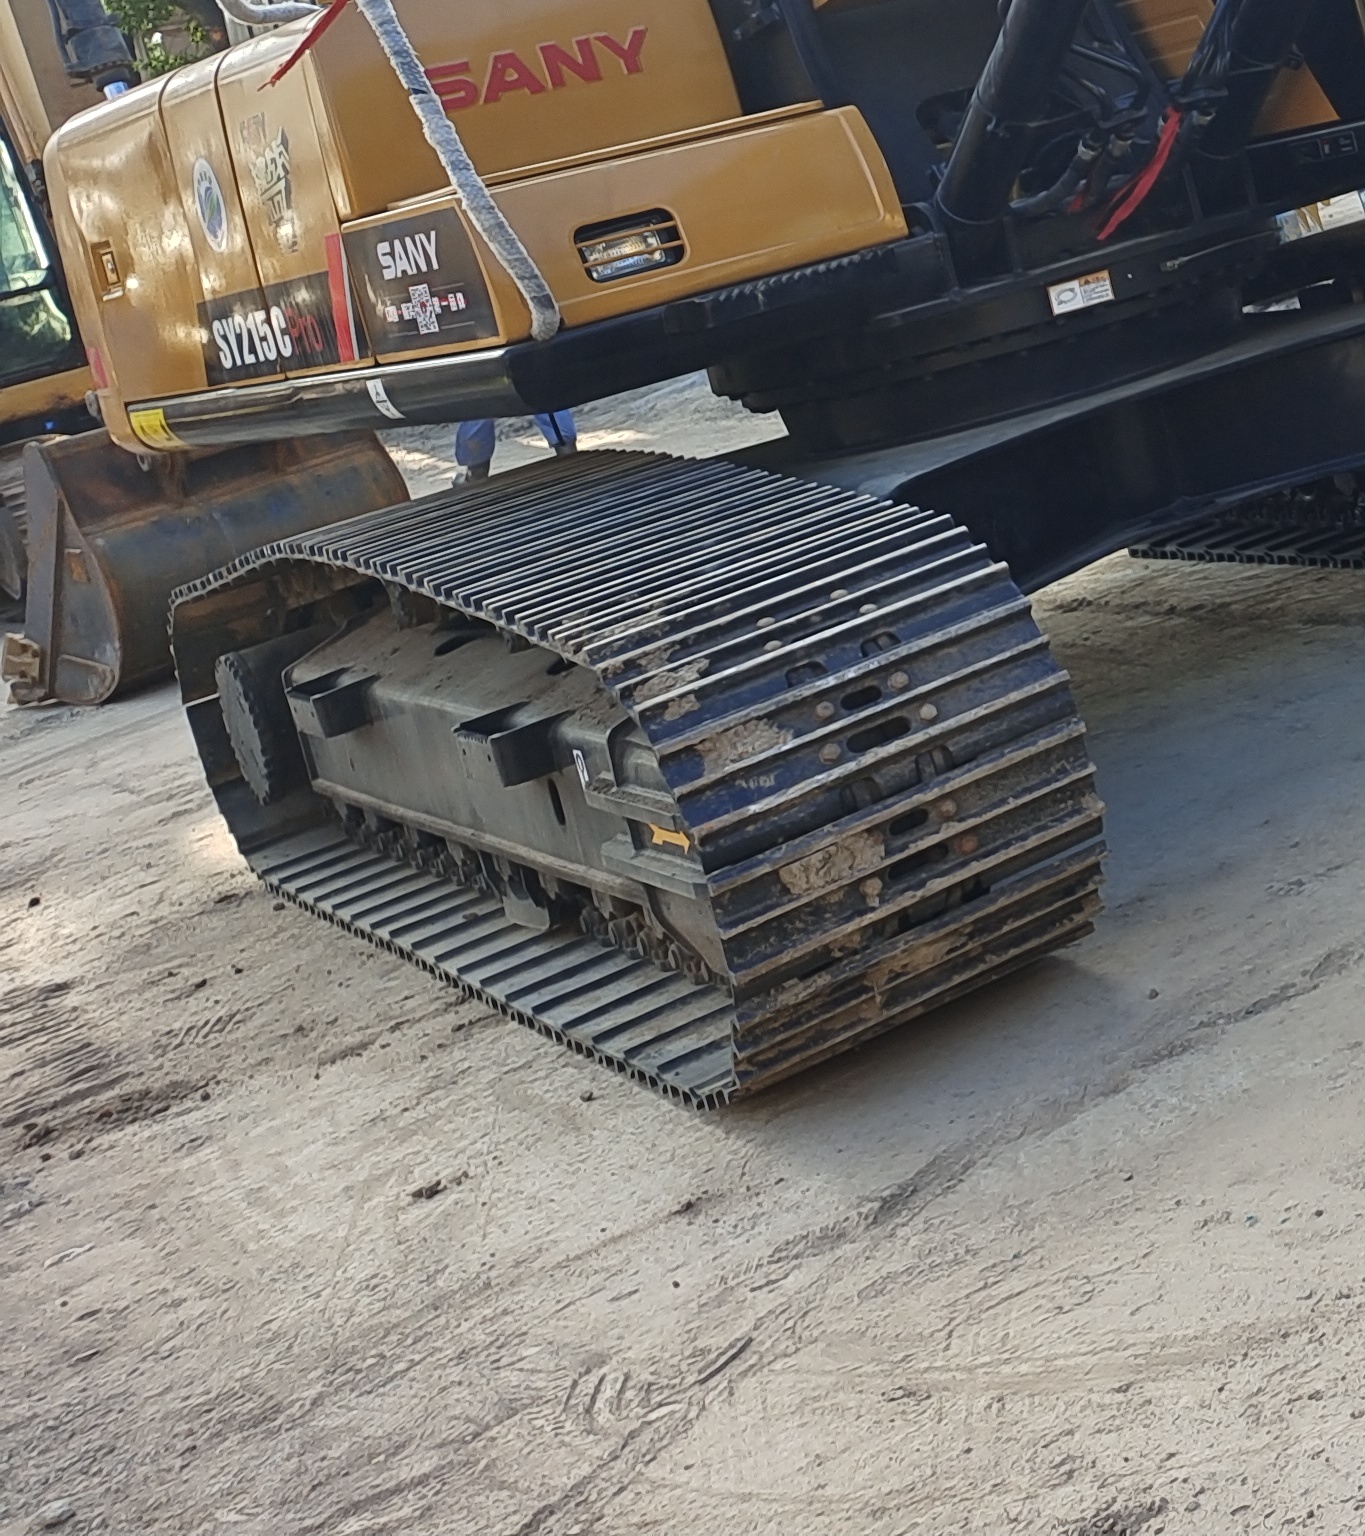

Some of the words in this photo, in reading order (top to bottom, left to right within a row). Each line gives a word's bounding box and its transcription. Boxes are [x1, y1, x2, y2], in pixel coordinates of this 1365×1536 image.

[424, 25, 648, 113] SANY
[376, 230, 439, 281] SANY
[212, 305, 293, 370] SY215C
[284, 306, 324, 356] Pro
